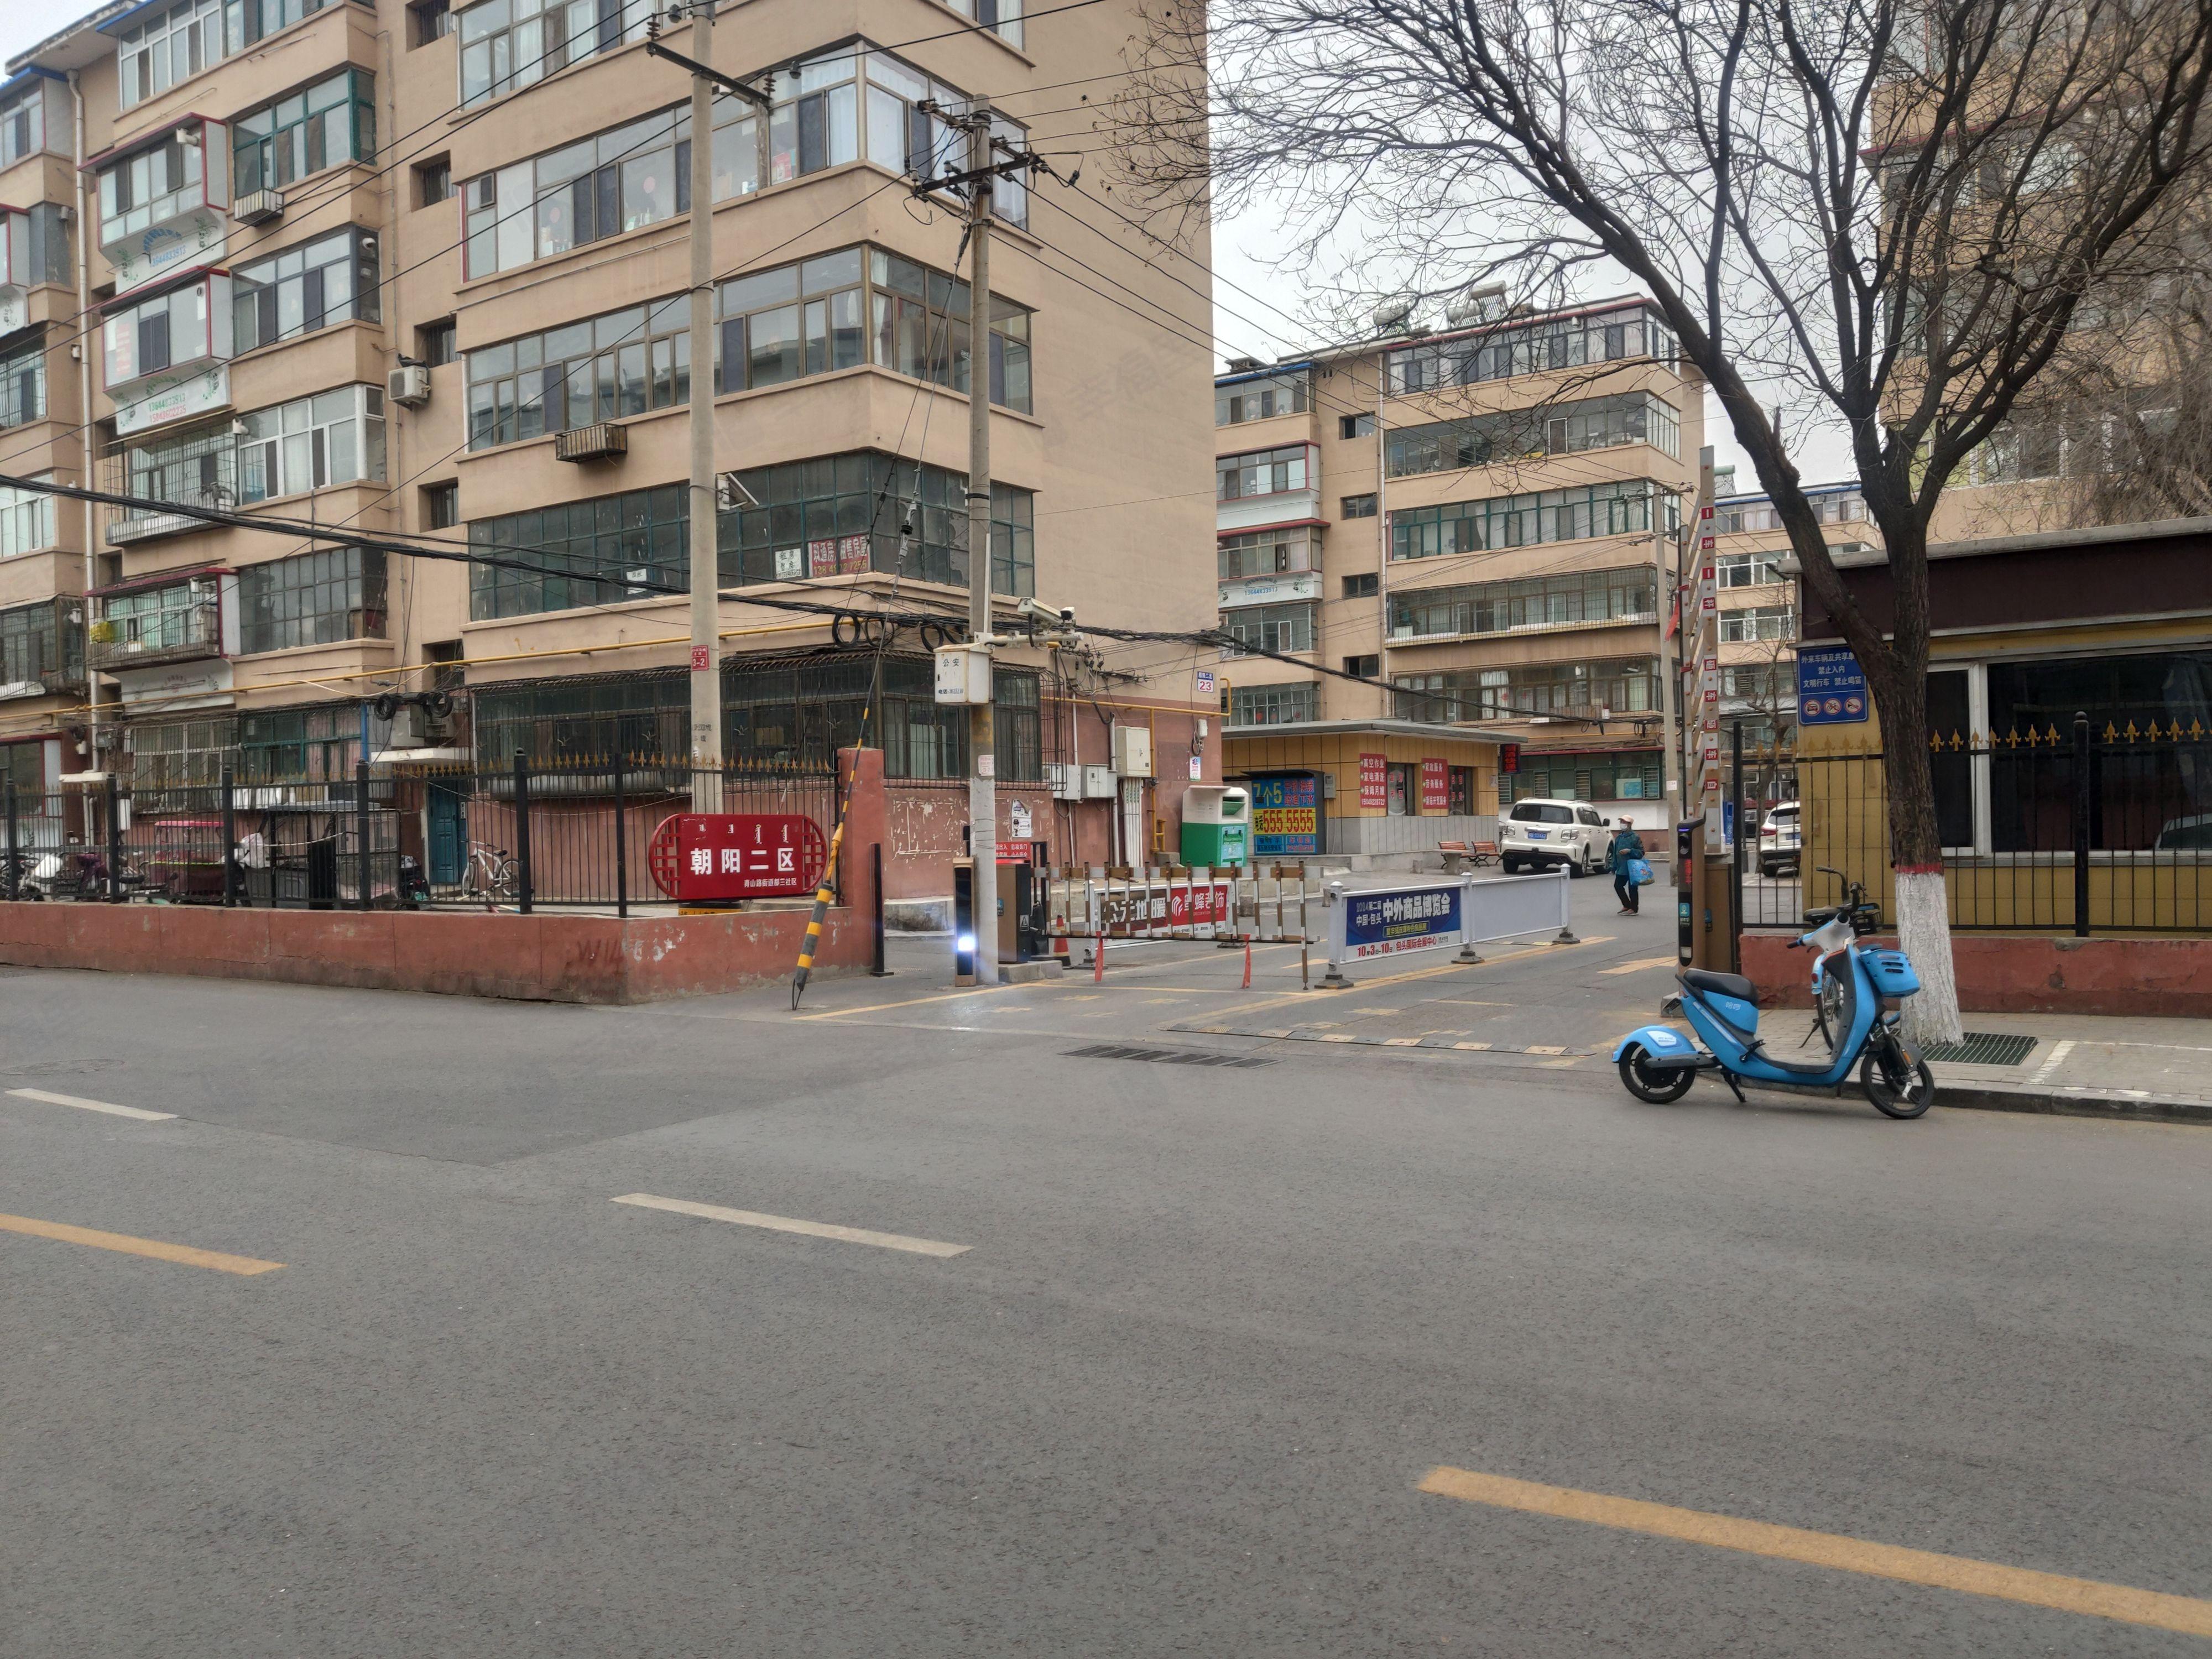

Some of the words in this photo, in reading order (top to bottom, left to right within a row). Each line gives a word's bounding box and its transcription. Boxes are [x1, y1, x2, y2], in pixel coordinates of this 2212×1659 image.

[943, 658, 959, 667] 公安
[1818, 665, 1845, 675] 禁止入内
[1199, 681, 1211, 690] 23
[1803, 677, 1830, 688] 文明行车
[1286, 809, 1313, 833] 5555
[690, 847, 795, 875] 朝阳二区
[1383, 892, 1451, 923] 中外商品博览会
[1396, 936, 1437, 951] 包头国际会展中心
